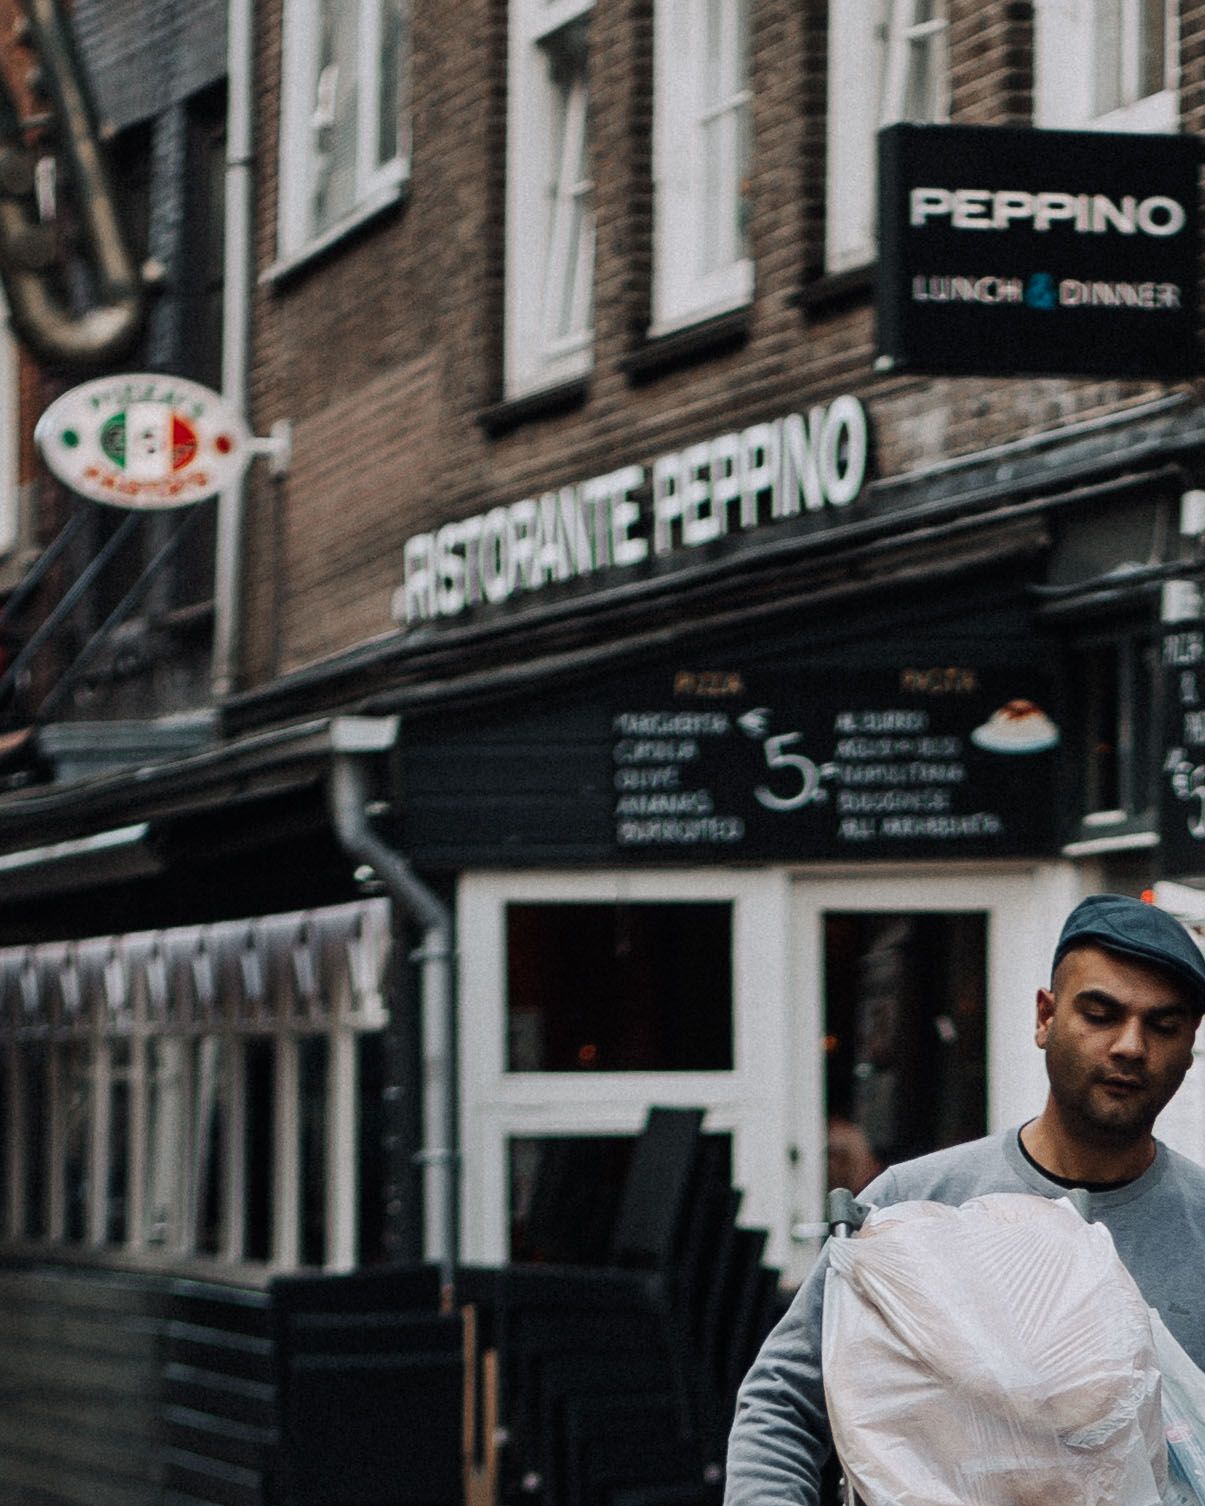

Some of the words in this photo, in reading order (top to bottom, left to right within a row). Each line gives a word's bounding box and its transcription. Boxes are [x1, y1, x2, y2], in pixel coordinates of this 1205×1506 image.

[909, 187, 1186, 237] PEPPINO
[912, 274, 1024, 304] LUNCH
[1059, 279, 1183, 309] DINNER
[400, 462, 649, 605] RISTORANTE
[652, 394, 868, 556] PEPPINO
